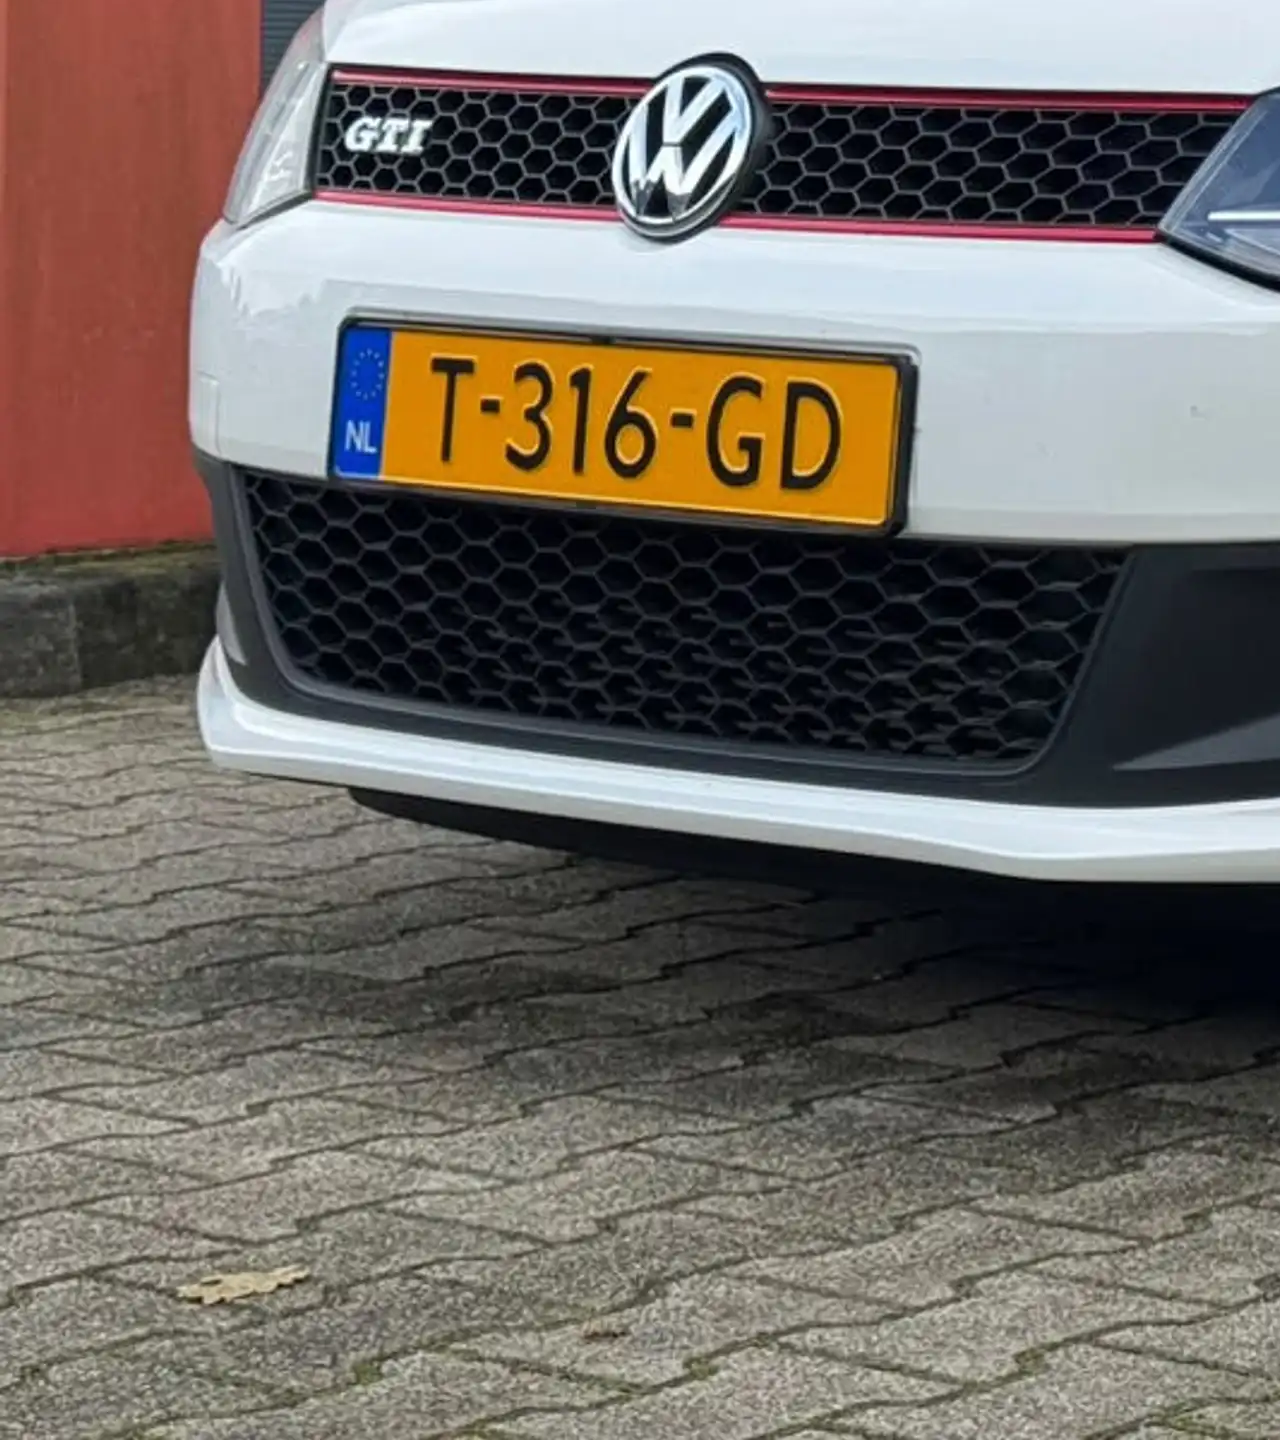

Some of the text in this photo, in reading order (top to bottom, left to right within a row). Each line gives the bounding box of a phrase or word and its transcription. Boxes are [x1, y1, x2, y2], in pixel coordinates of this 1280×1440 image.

[344, 115, 433, 153] GTI
[344, 419, 378, 454] NL
[429, 355, 843, 491] T-316-GD
